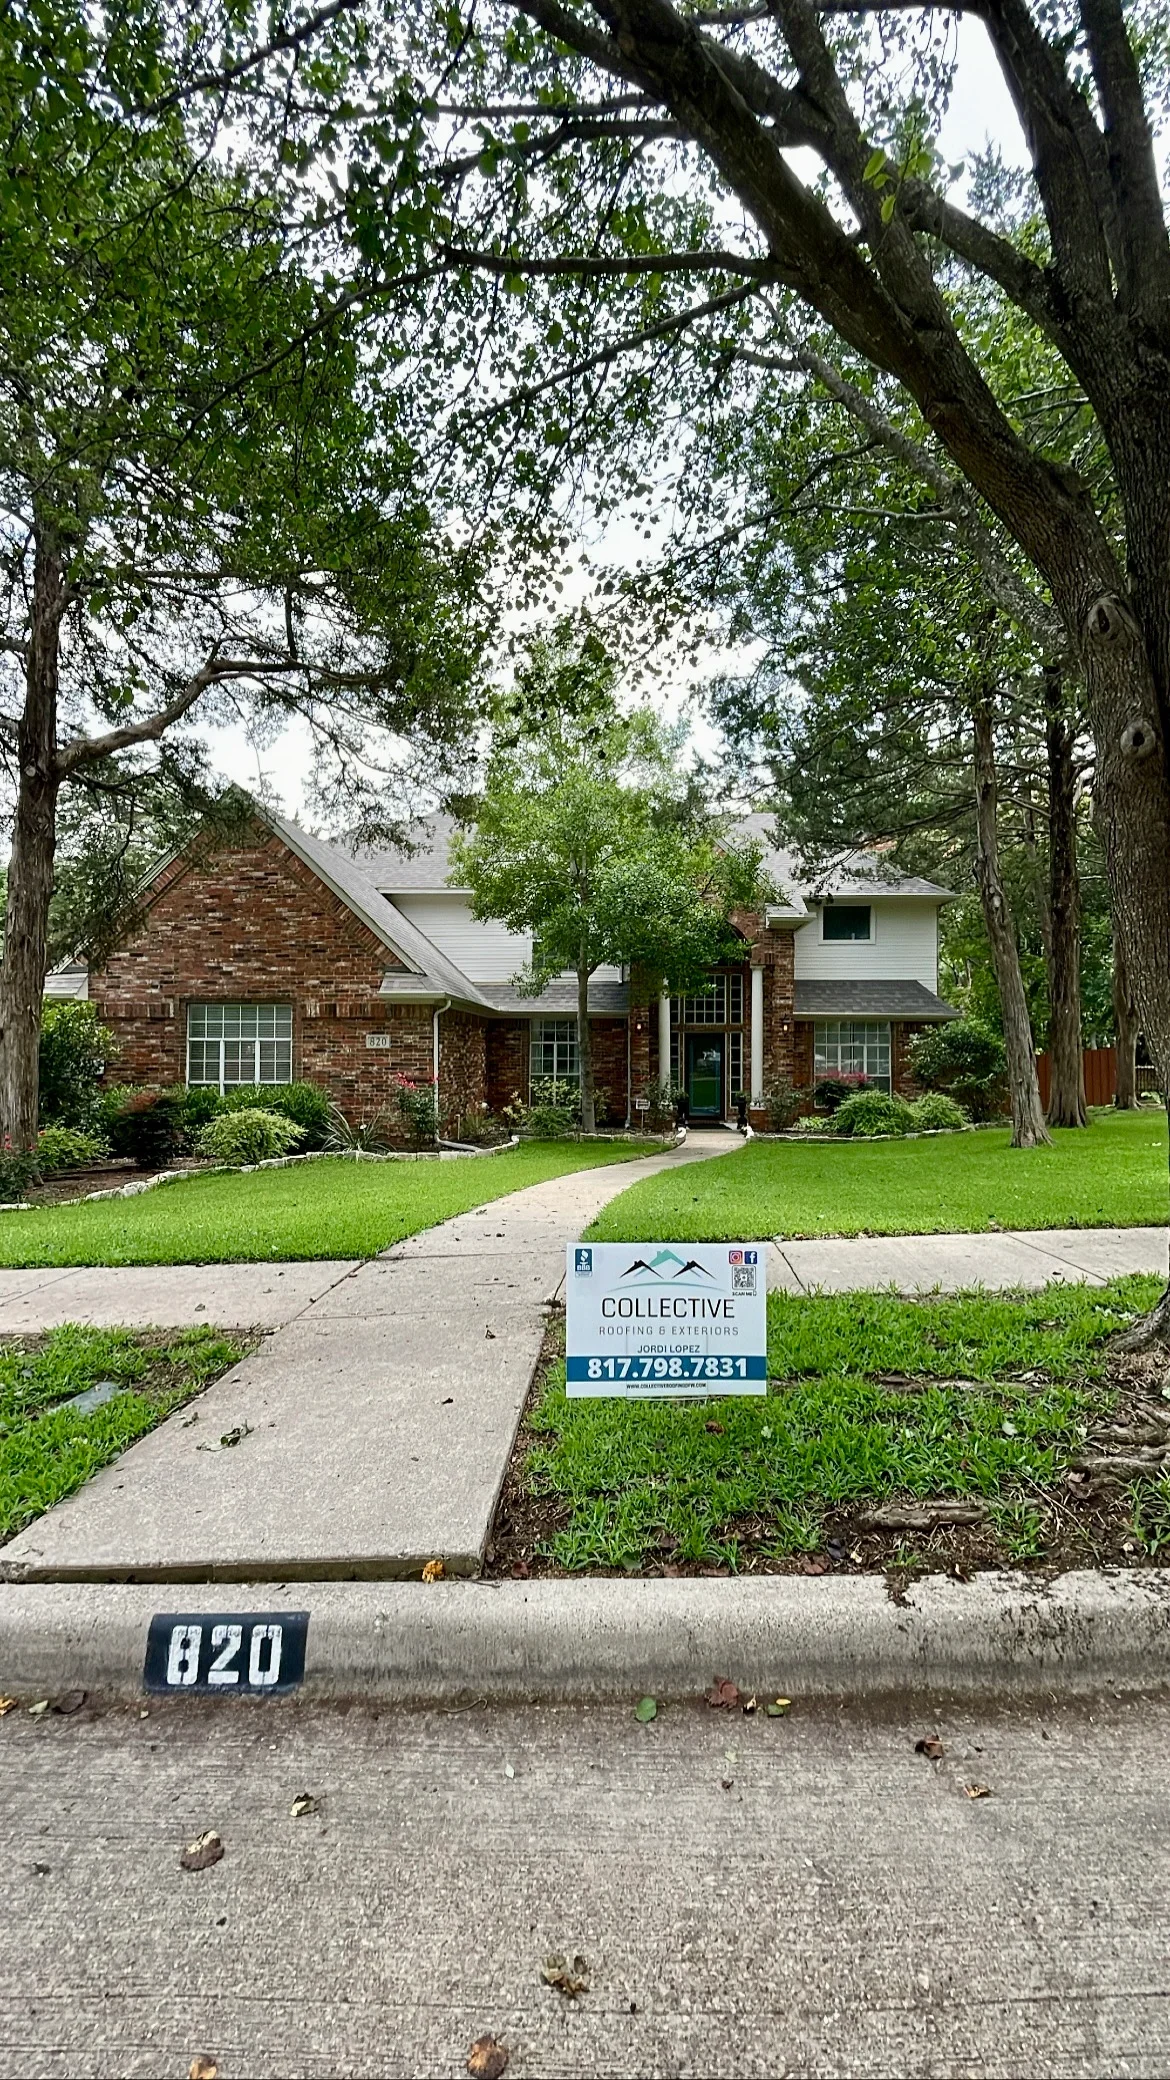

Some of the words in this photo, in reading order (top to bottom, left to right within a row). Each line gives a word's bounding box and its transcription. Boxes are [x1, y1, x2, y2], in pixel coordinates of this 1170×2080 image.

[369, 1036, 387, 1047] 820
[601, 1297, 735, 1319] COLLECTIVE
[599, 1326, 653, 1336] ROOFING
[659, 1326, 666, 1335] &
[671, 1326, 739, 1336] EXTERIORS
[637, 1344, 667, 1353] JORDI
[669, 1344, 700, 1353] LOPEZ
[587, 1356, 747, 1379] 817.798.7831
[167, 1624, 283, 1685] 820
